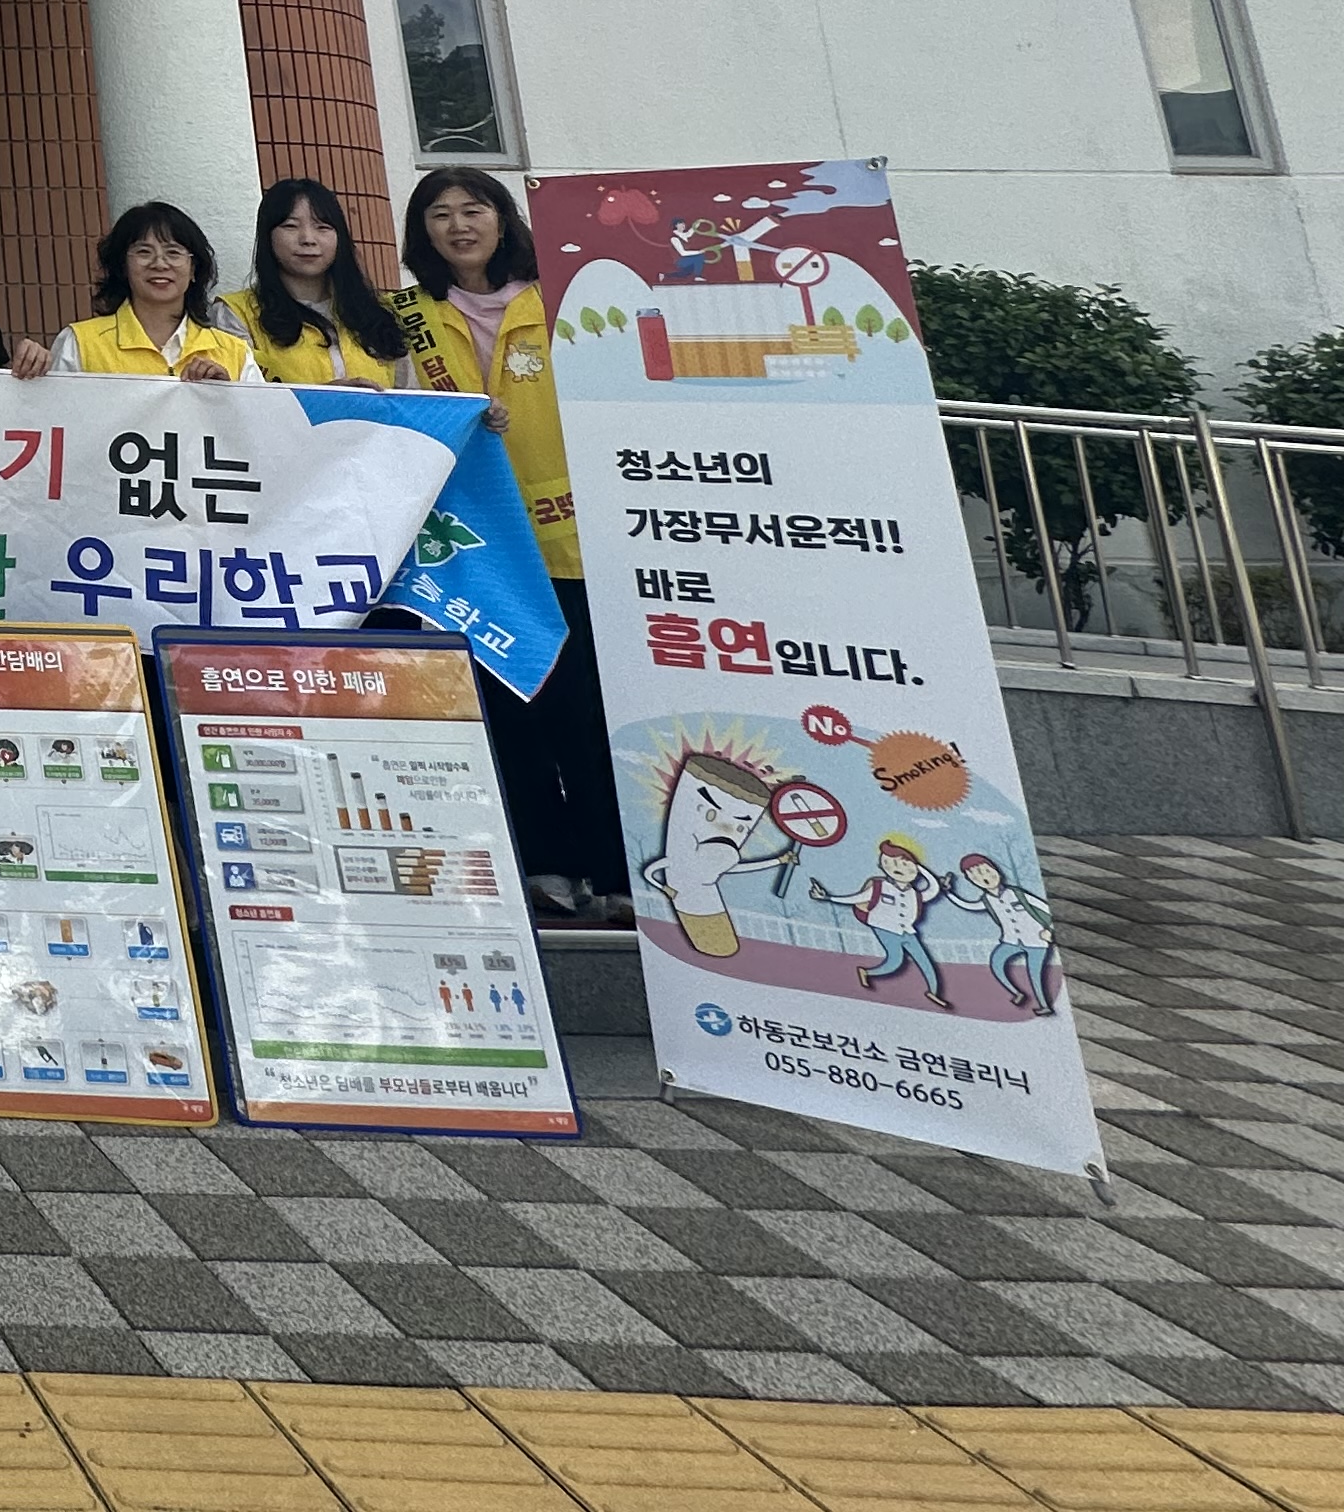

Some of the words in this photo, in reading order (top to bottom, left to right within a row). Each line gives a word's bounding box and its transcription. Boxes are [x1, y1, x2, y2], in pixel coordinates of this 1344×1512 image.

[108, 430, 261, 525] 없는
[615, 447, 773, 488] 청소년의
[625, 506, 902, 556] 가장무서운적!!
[50, 535, 383, 630] 우리학교
[636, 568, 715, 606] 바로
[645, 611, 925, 687] 흡연입니다.
[201, 666, 290, 693] 흡연으로
[294, 669, 337, 694] 인한
[342, 671, 387, 696] 폐해
[807, 712, 851, 739] No
[873, 740, 968, 794] Smoking!
[735, 1011, 891, 1064] 하동군보건소
[895, 1041, 1031, 1097] 금연클리닉
[380, 1077, 472, 1097] 부모님들로부터
[764, 1049, 966, 1113] 055-880-6665
